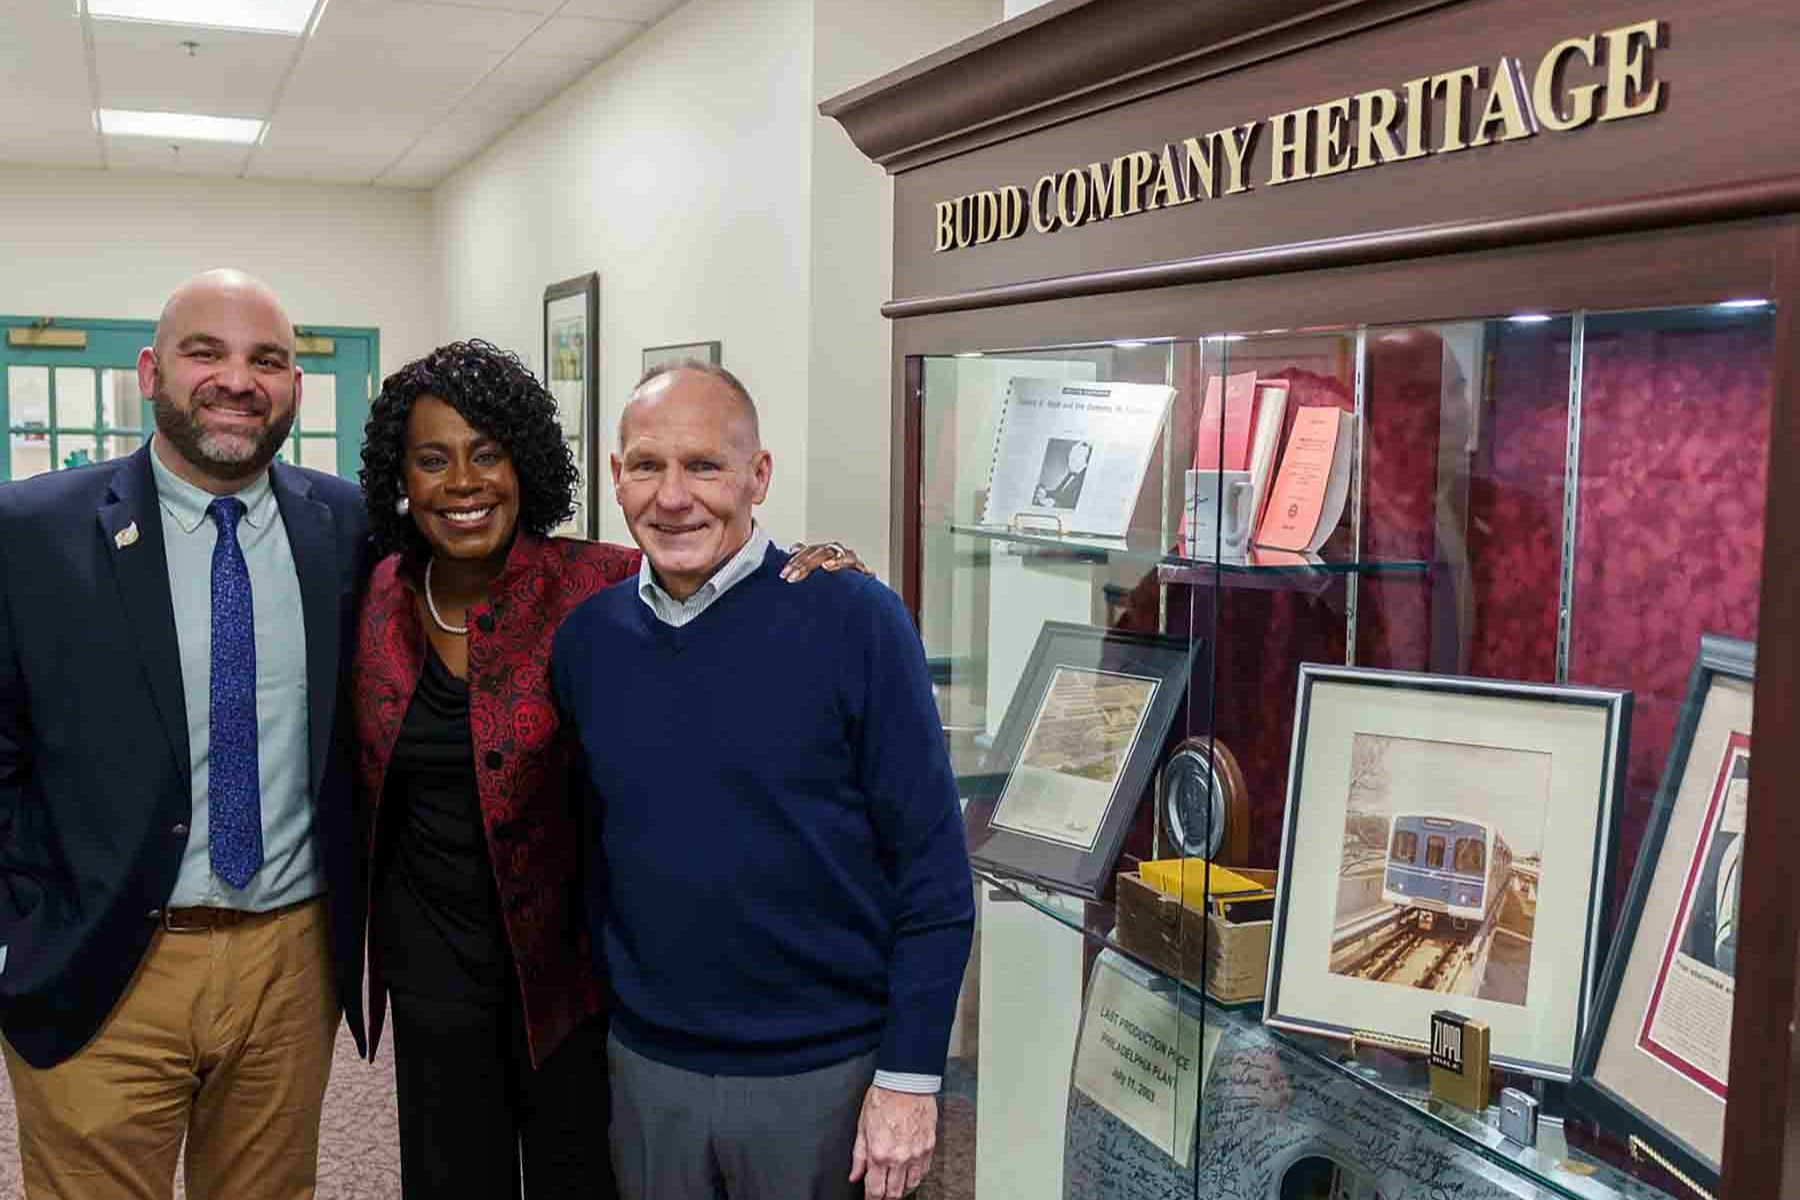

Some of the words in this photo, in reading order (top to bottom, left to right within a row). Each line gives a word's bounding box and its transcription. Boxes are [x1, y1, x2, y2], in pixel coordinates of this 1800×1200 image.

[934, 184, 1026, 253] BUDD
[1032, 122, 1262, 234] COMPANY
[1266, 20, 1664, 187] HERITAGE
[1100, 1006, 1119, 1025] LAST
[1119, 1017, 1167, 1055] PRODUCTION
[1167, 1045, 1190, 1071] PCE
[1433, 1019, 1461, 1062] ZIPPO
